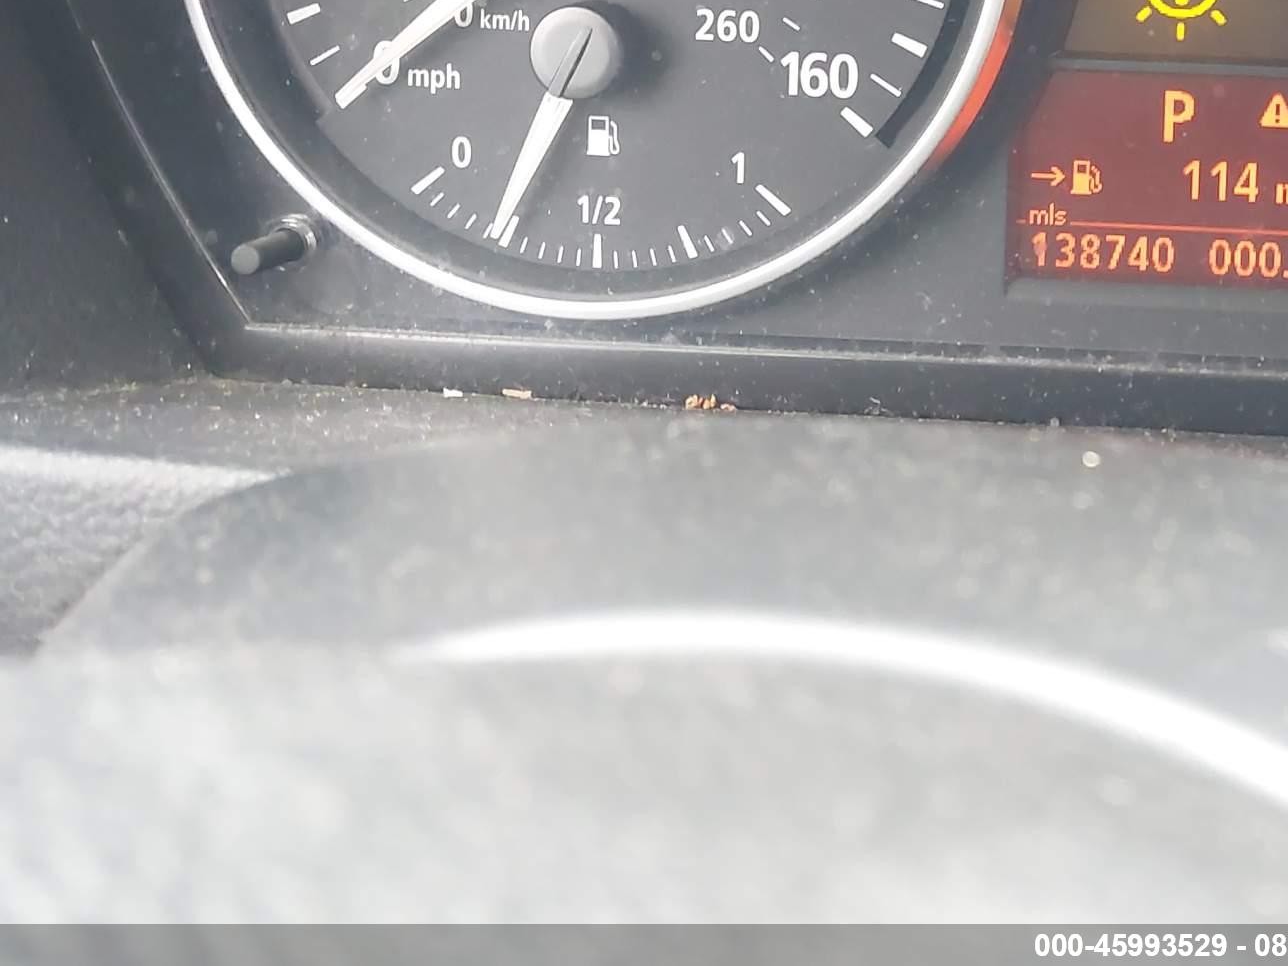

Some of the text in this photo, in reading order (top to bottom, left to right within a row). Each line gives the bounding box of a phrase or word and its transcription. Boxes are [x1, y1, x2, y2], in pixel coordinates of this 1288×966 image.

[479, 8, 530, 34] km/h
[695, 8, 760, 42] 260
[371, 39, 461, 93] 0 mph
[780, 50, 858, 99] 160
[1163, 90, 1195, 142] P
[451, 136, 471, 168] 0
[731, 153, 746, 183] 1
[1184, 161, 1259, 203] 114
[578, 195, 621, 227] 1/2
[1029, 203, 1067, 225] mls
[1032, 232, 1175, 272] 138740
